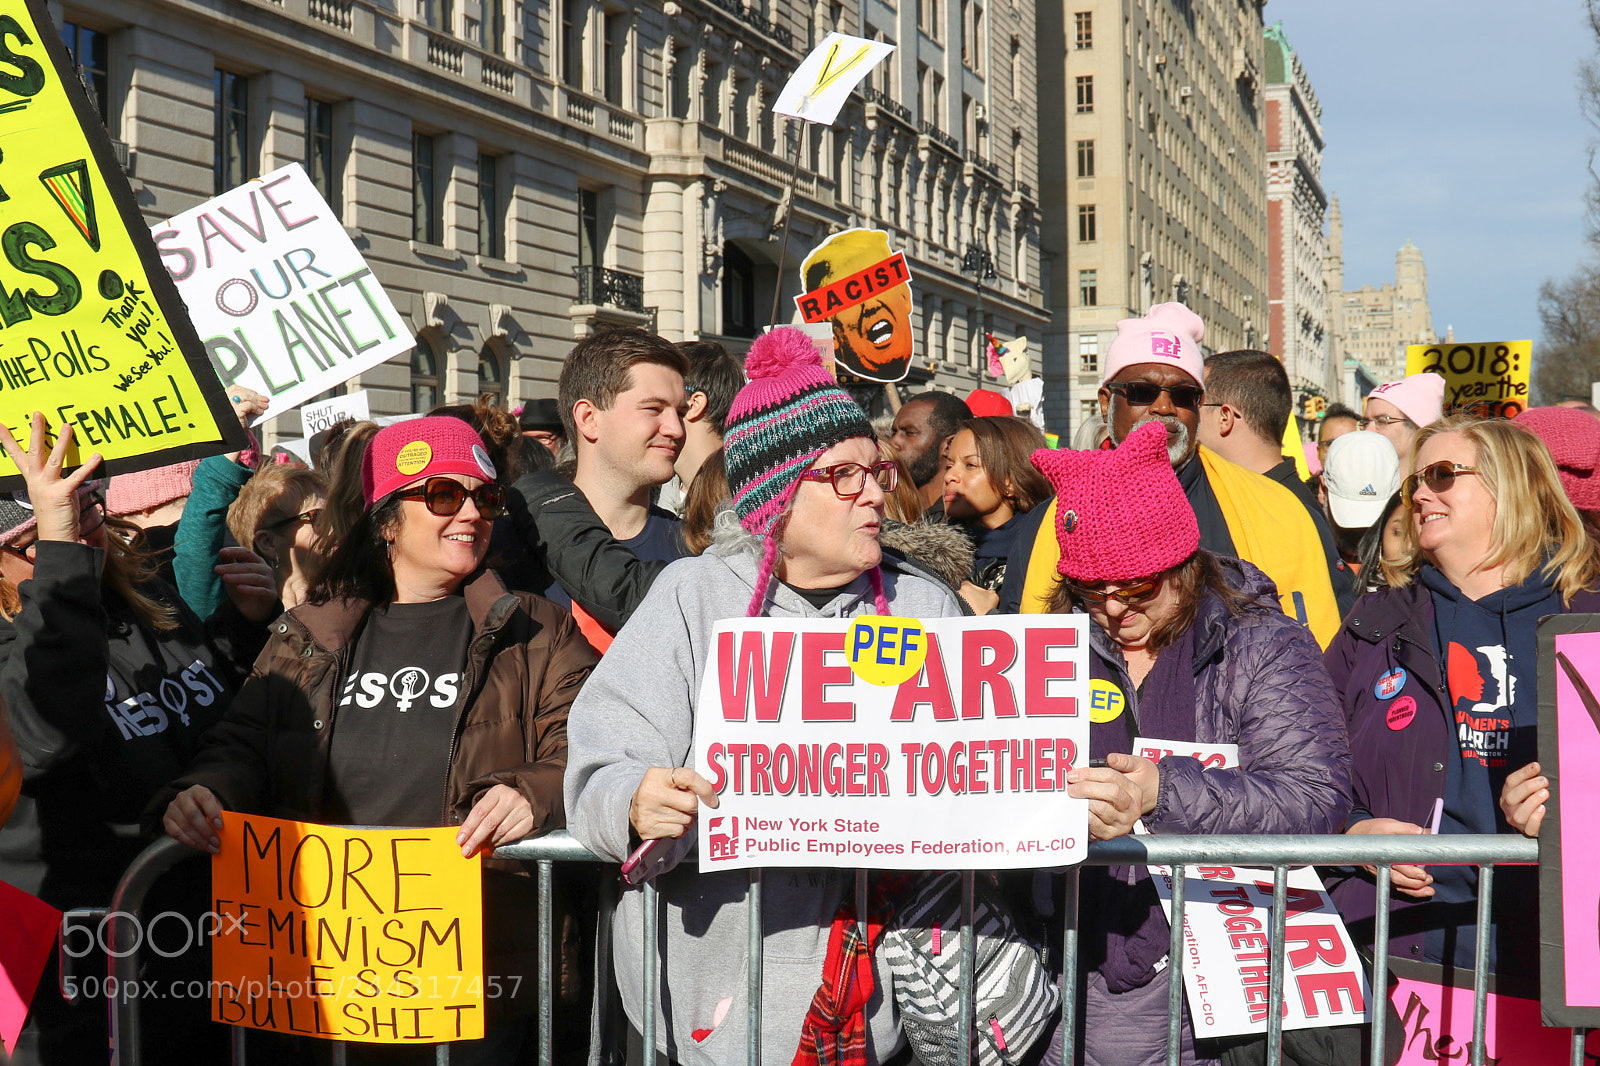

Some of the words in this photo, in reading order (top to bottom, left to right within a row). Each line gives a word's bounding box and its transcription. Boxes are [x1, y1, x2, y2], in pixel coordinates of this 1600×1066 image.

[152, 174, 319, 282] SAVE
[101, 280, 145, 328] Thank
[215, 248, 332, 317] OUR
[801, 259, 904, 322] RACIST
[203, 266, 397, 396] PLANET
[113, 374, 135, 392] We
[131, 361, 153, 380] See
[1422, 345, 1520, 376] 2018:
[57, 375, 196, 446] FEMALE!
[1450, 382, 1496, 404] year
[1496, 374, 1528, 399] the
[306, 405, 334, 422] SHUT
[852, 623, 922, 666] PEF
[717, 630, 856, 722] WE
[889, 628, 1079, 721] ARE
[1382, 686, 1396, 696] REAL
[1089, 690, 1121, 710] EF
[1387, 711, 1414, 724] PARENTHOOD
[1391, 705, 1410, 716] PLANNED
[706, 742, 890, 797] STRONGER
[901, 737, 1078, 795] TOGETHER
[745, 816, 783, 831] New
[788, 817, 828, 832] York
[834, 818, 880, 833] State
[243, 820, 443, 914] MORE
[745, 837, 800, 852] Public
[806, 839, 905, 857] Employees
[911, 838, 1010, 856] Federation,
[1016, 837, 1076, 853] AFL-CIO
[1253, 880, 1368, 1018] ARE
[268, 956, 419, 999] LESS
[1195, 973, 1215, 1027] AFL-CIO
